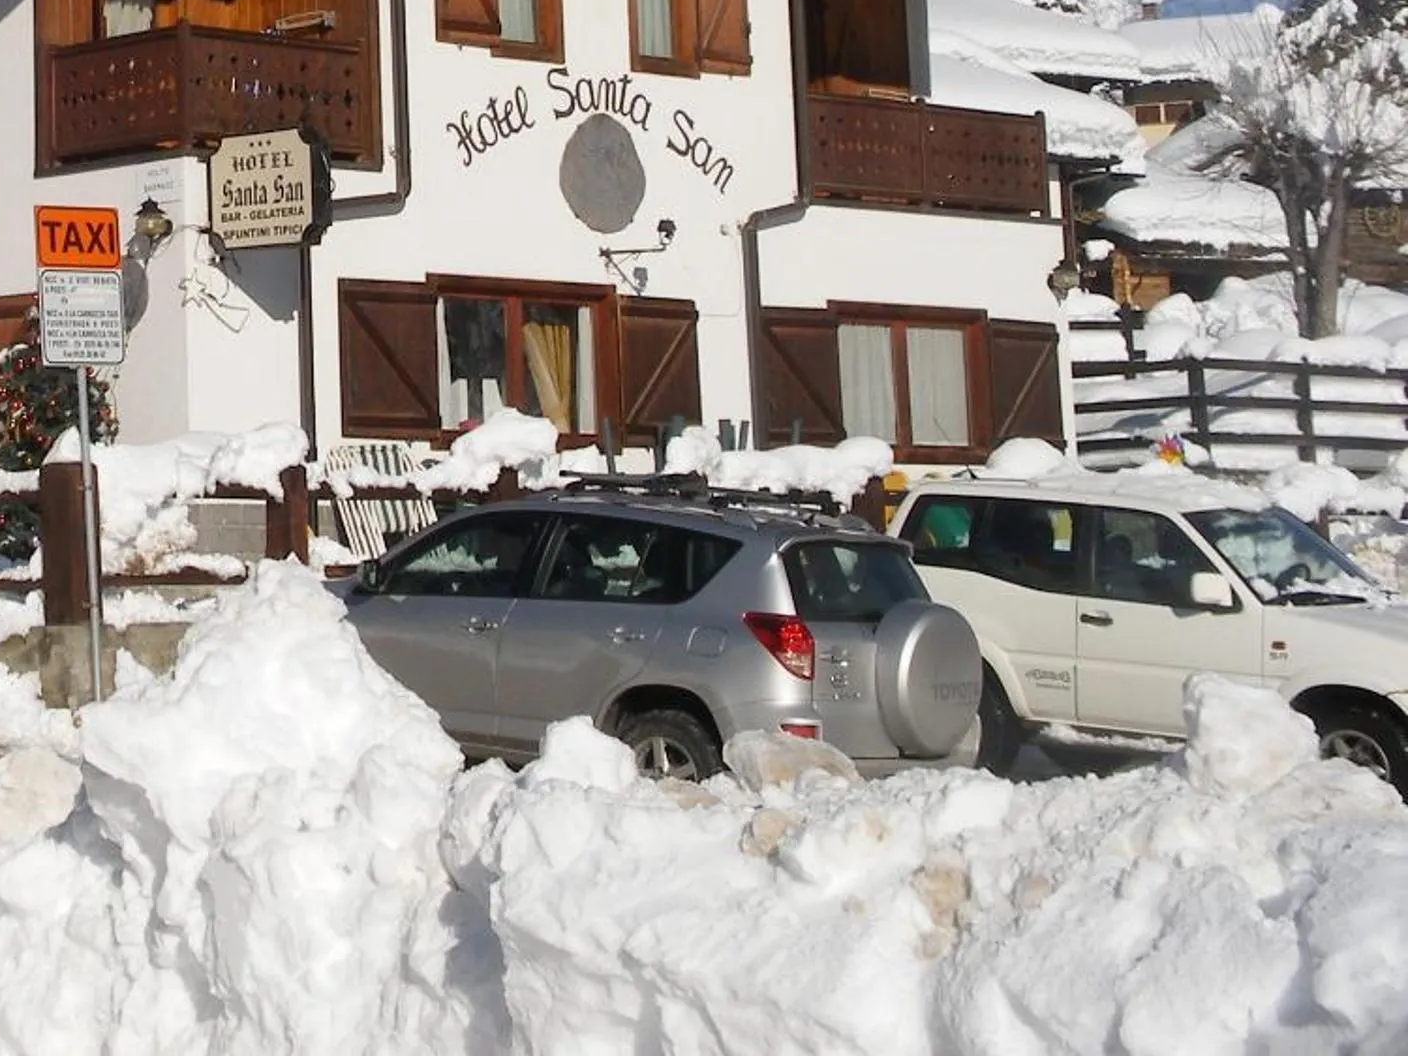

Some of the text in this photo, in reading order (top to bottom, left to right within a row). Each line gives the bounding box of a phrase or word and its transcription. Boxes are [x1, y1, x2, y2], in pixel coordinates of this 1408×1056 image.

[446, 67, 734, 194] Hotel Santa San
[232, 150, 294, 173] HOTEL
[221, 174, 304, 209] Santa San
[220, 211, 242, 223] BAR
[249, 205, 305, 220] GELATERIA
[41, 221, 116, 255] TAXI
[222, 224, 303, 240] SPUNTINI TIPICI
